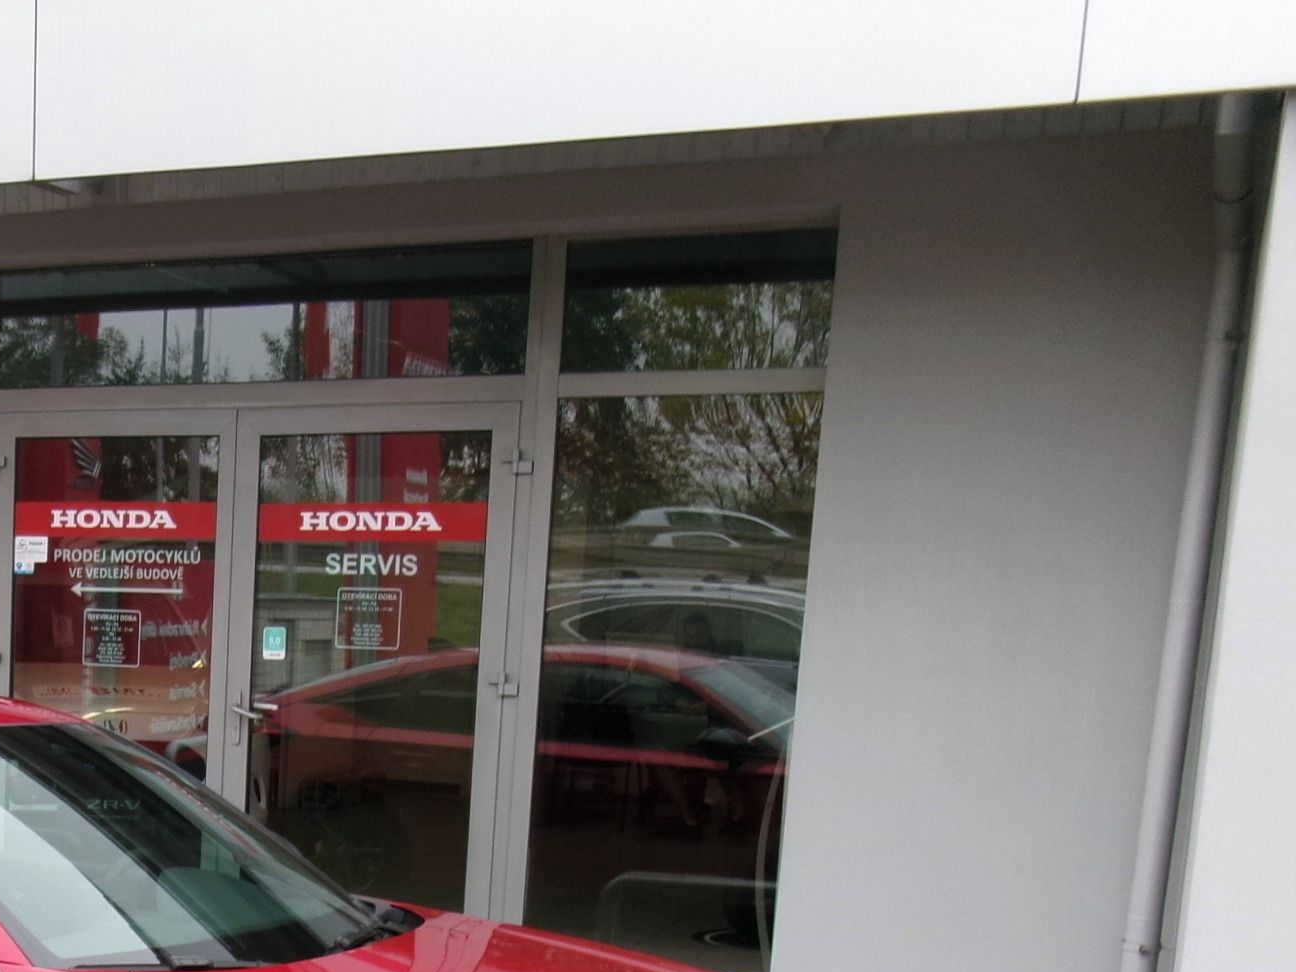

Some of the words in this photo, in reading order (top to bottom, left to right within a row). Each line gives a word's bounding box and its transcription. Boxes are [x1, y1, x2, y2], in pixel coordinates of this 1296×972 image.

[51, 509, 177, 529] HONDA
[299, 511, 442, 532] HONDA
[53, 548, 106, 563] PRODEJ
[110, 545, 201, 564] MOTOCYKLŮ
[325, 552, 418, 576] SERVIS
[69, 567, 83, 578] VE
[85, 565, 134, 580] VEDLEJŠÍ
[136, 566, 184, 580] BUDOVĚ
